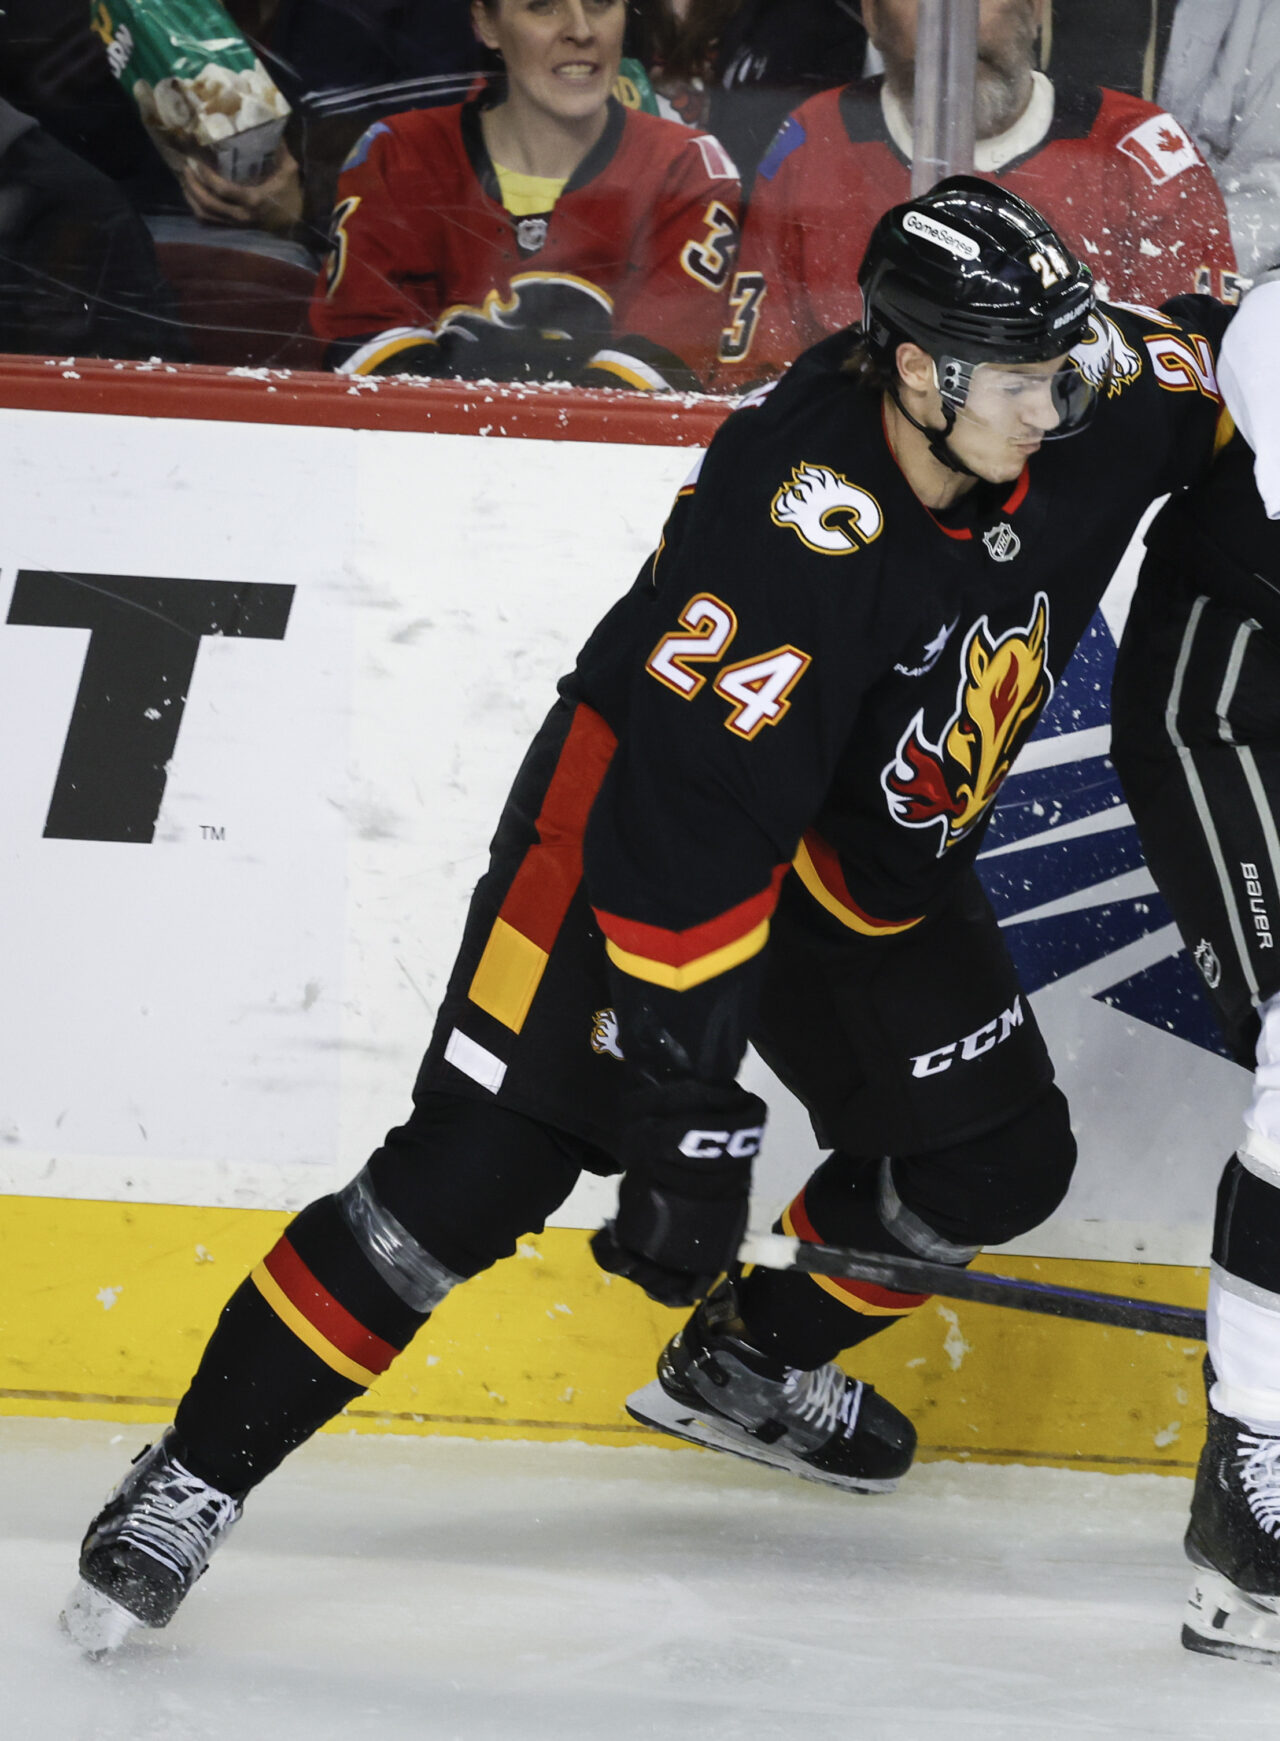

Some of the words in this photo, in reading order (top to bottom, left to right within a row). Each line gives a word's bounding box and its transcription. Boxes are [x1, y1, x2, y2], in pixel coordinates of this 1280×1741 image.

[907, 215, 973, 254] GameSense
[717, 270, 768, 363] 3
[645, 592, 812, 741] 24
[909, 995, 1024, 1078] CCM
